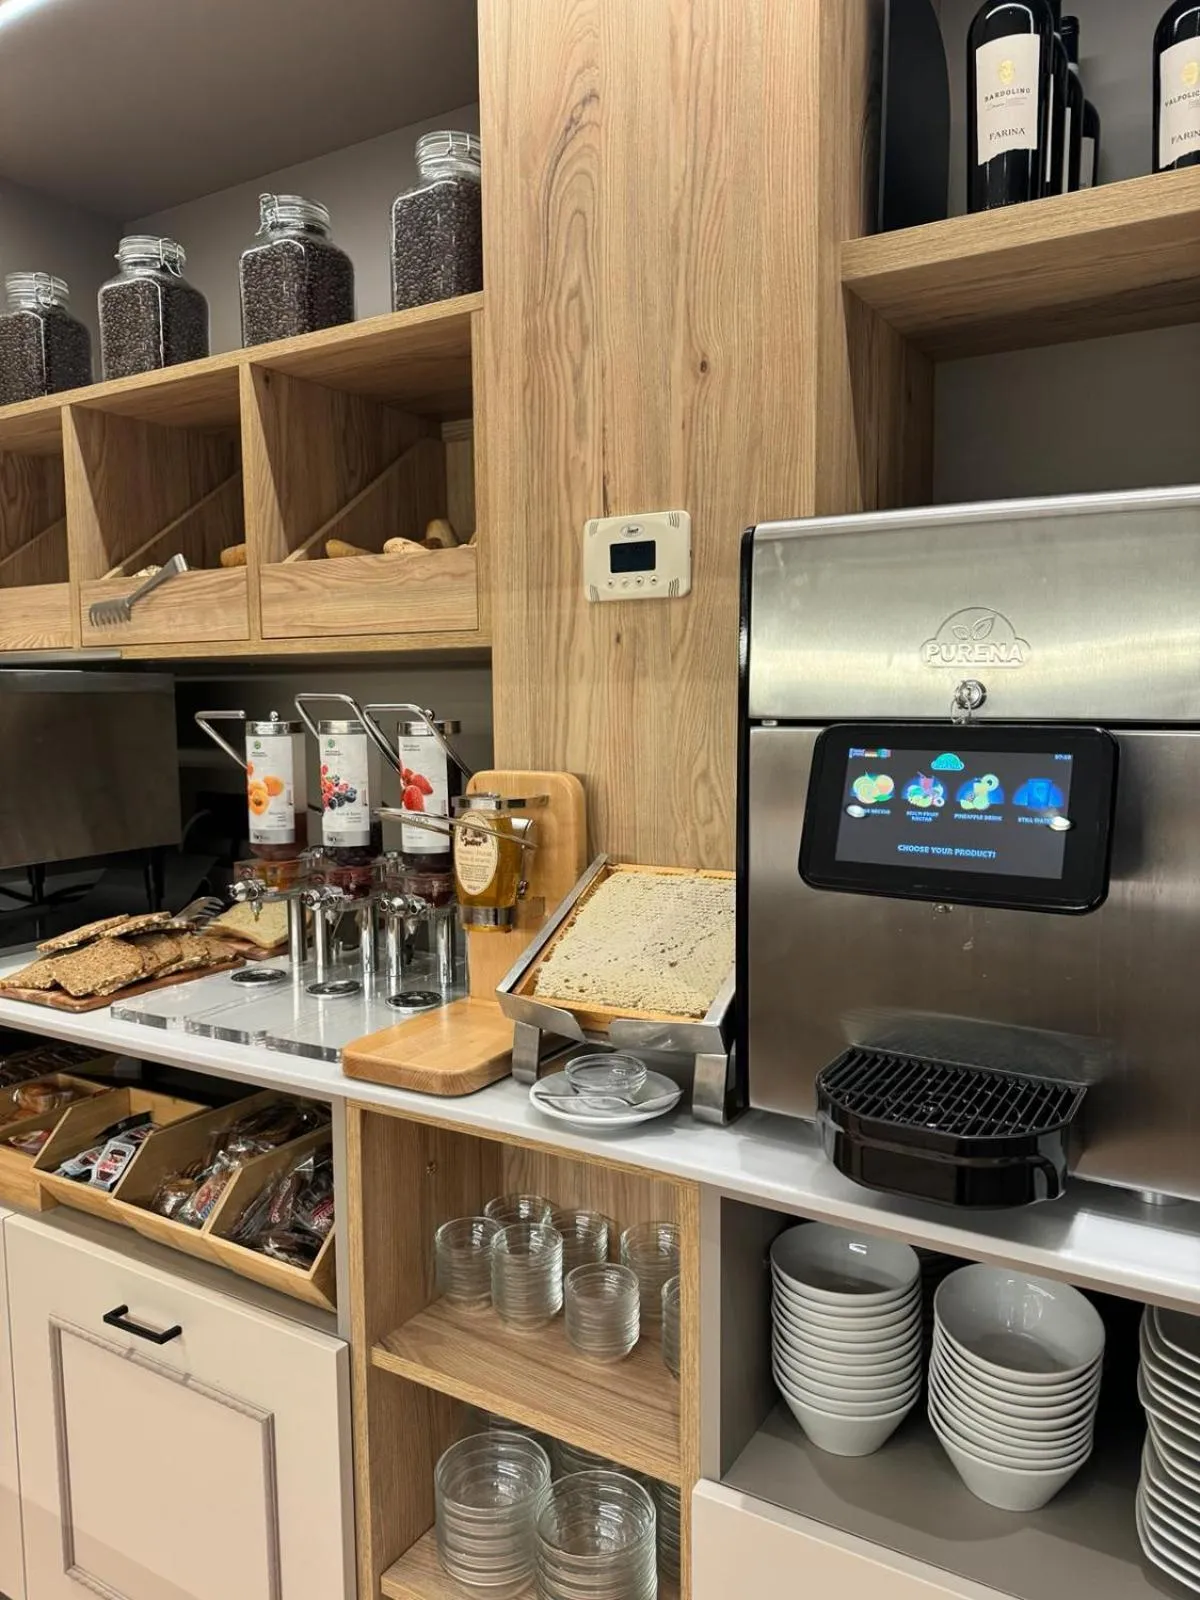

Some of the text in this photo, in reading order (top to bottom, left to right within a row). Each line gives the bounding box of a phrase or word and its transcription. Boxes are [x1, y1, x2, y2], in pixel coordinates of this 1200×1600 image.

[984, 87, 1031, 102] BARDOLINO
[989, 127, 1026, 141] FARINA
[925, 642, 1025, 663] PURENA
[897, 844, 997, 859] CHOOSE YOUR PRODUCT!
